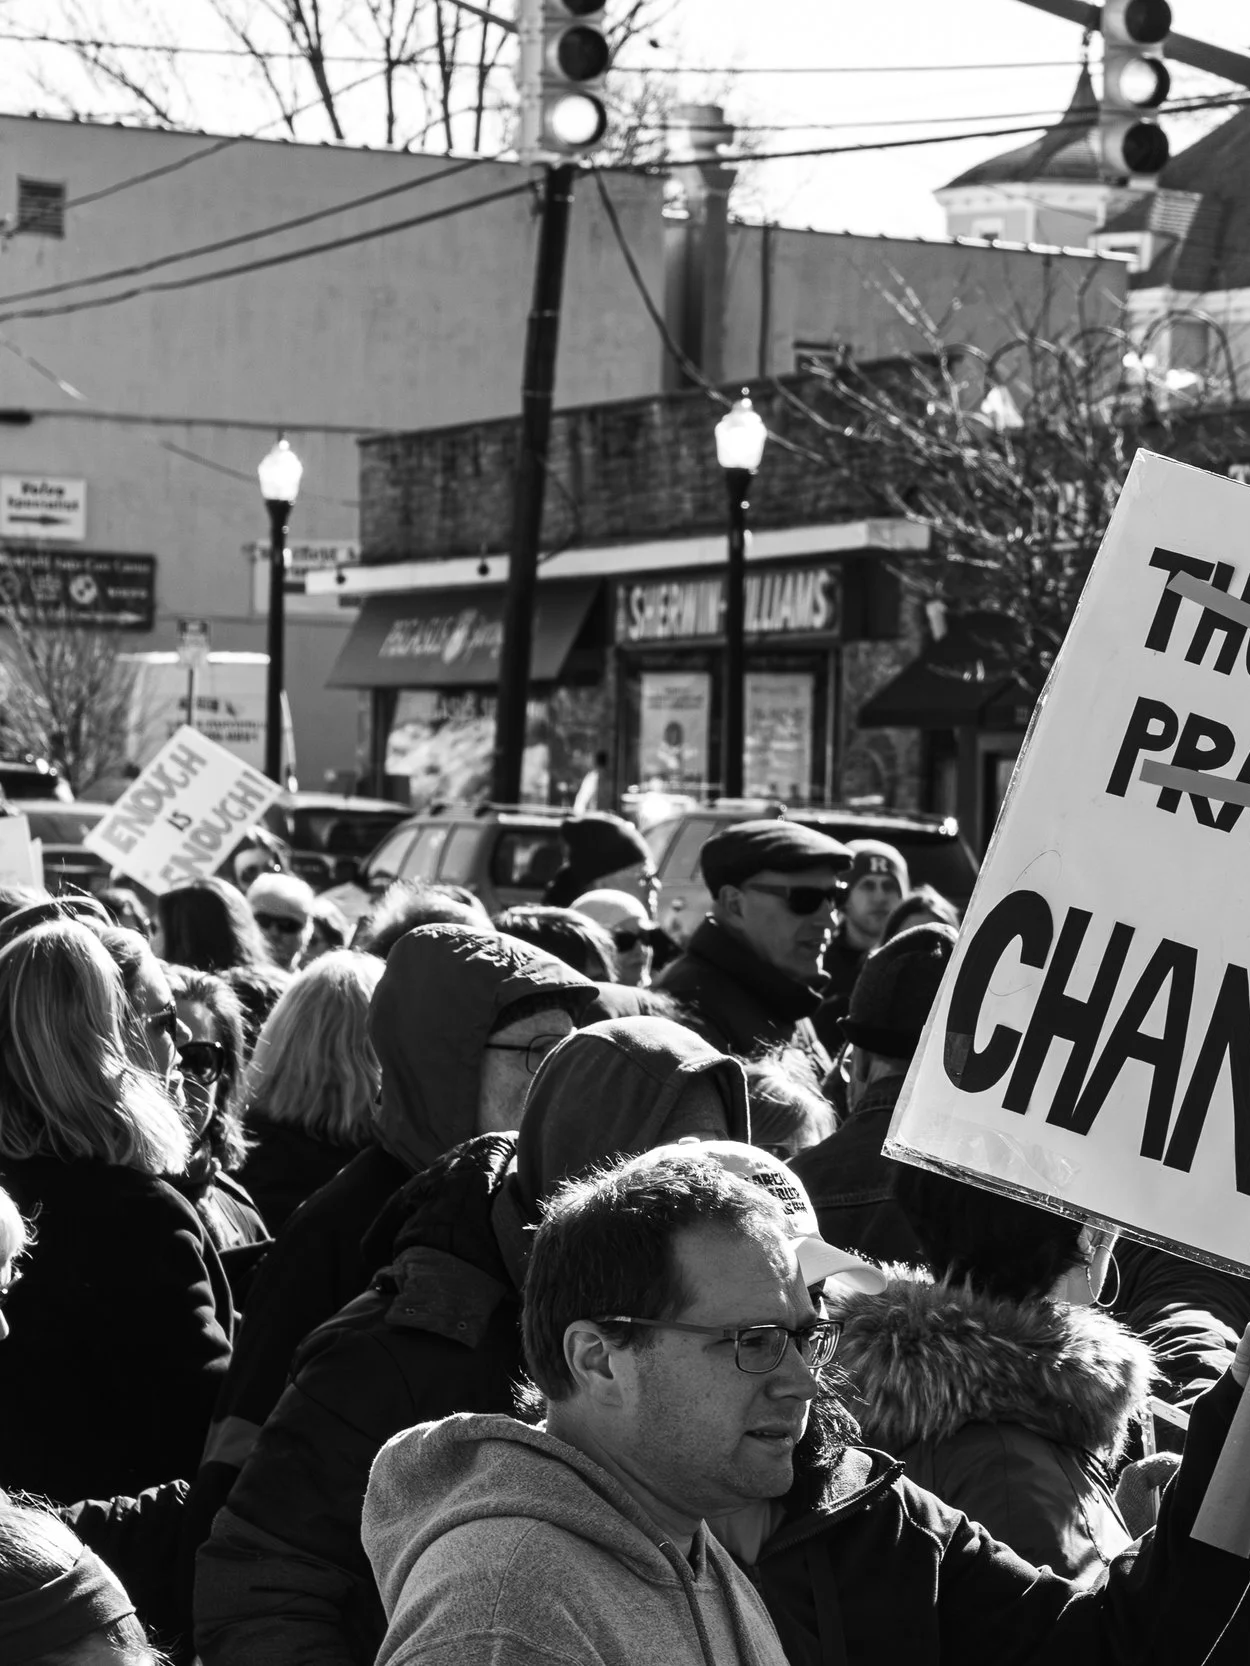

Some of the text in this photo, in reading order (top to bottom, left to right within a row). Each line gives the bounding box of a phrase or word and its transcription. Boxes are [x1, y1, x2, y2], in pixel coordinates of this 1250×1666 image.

[628, 569, 828, 641] SHERWIN-ILLIAMS
[166, 811, 193, 832] IS
[870, 856, 888, 873] R
